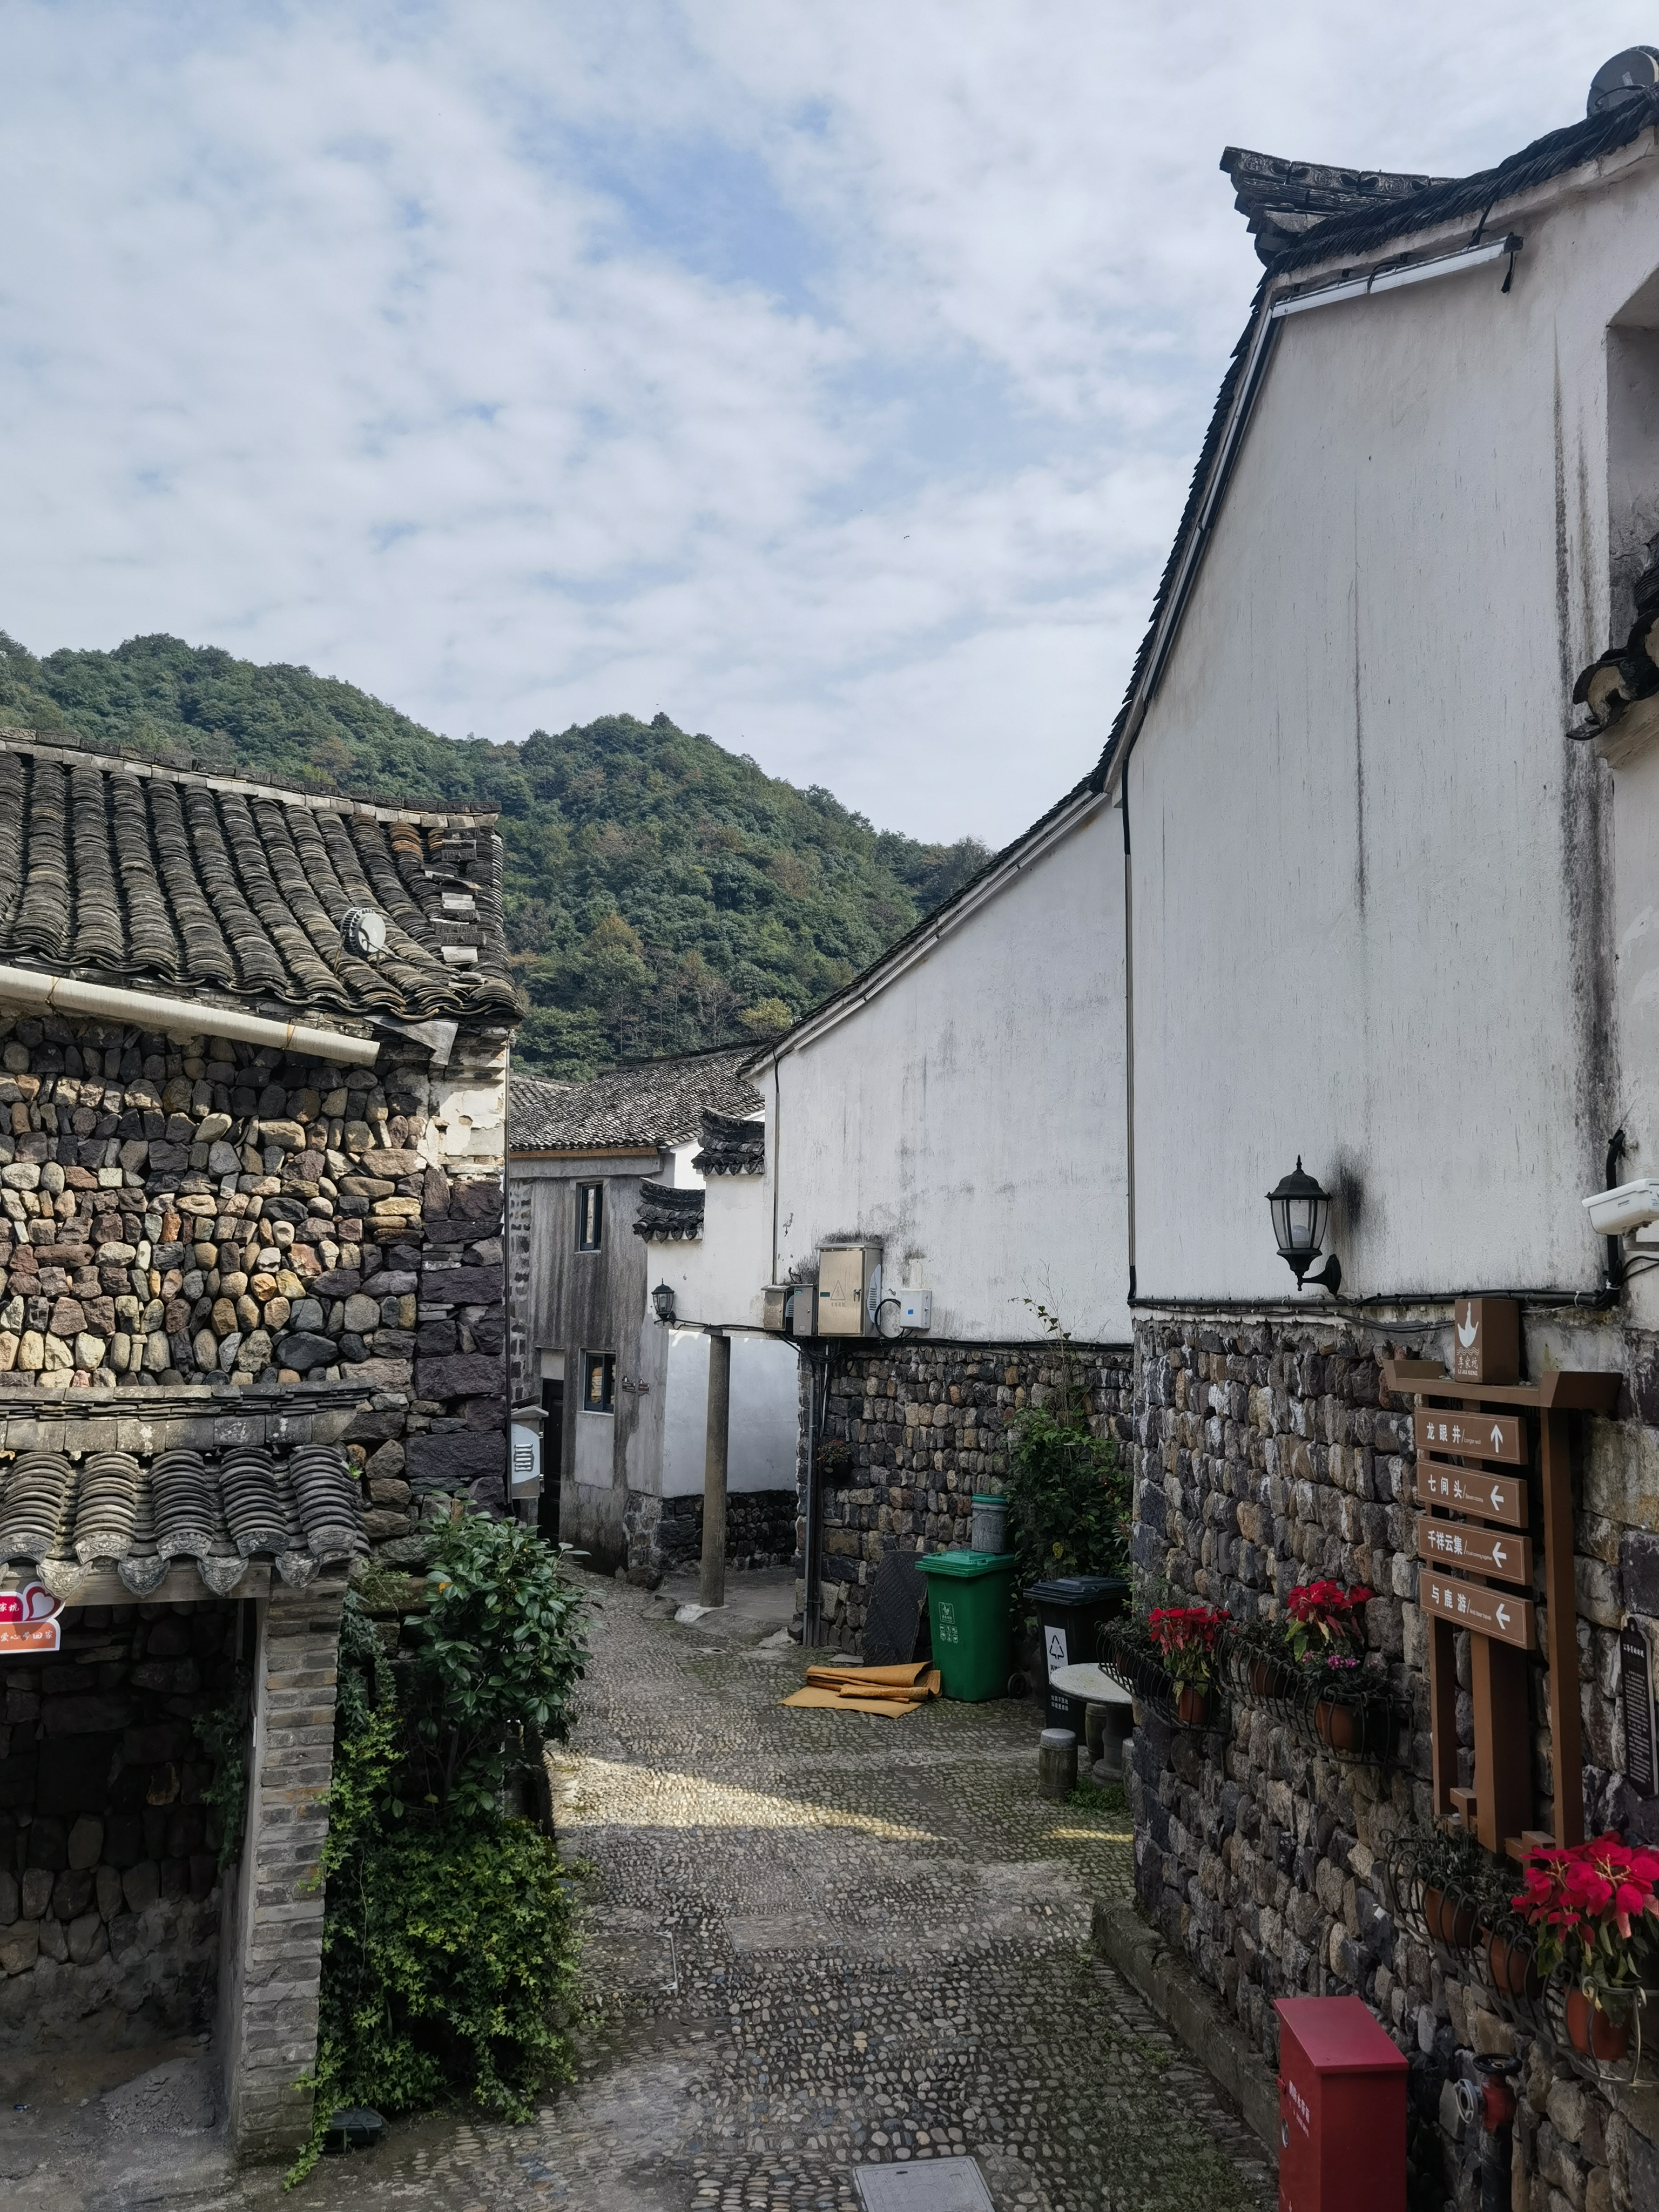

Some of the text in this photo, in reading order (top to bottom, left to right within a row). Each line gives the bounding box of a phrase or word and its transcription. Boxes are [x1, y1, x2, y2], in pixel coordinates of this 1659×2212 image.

[1458, 1354, 1479, 1370] 李家坑
[1426, 1421, 1461, 1444] 龙眼井
[1427, 1474, 1462, 1499] 七间头
[1427, 1530, 1463, 1555] 千祥云集
[1431, 1583, 1466, 1614] 与鹿游
